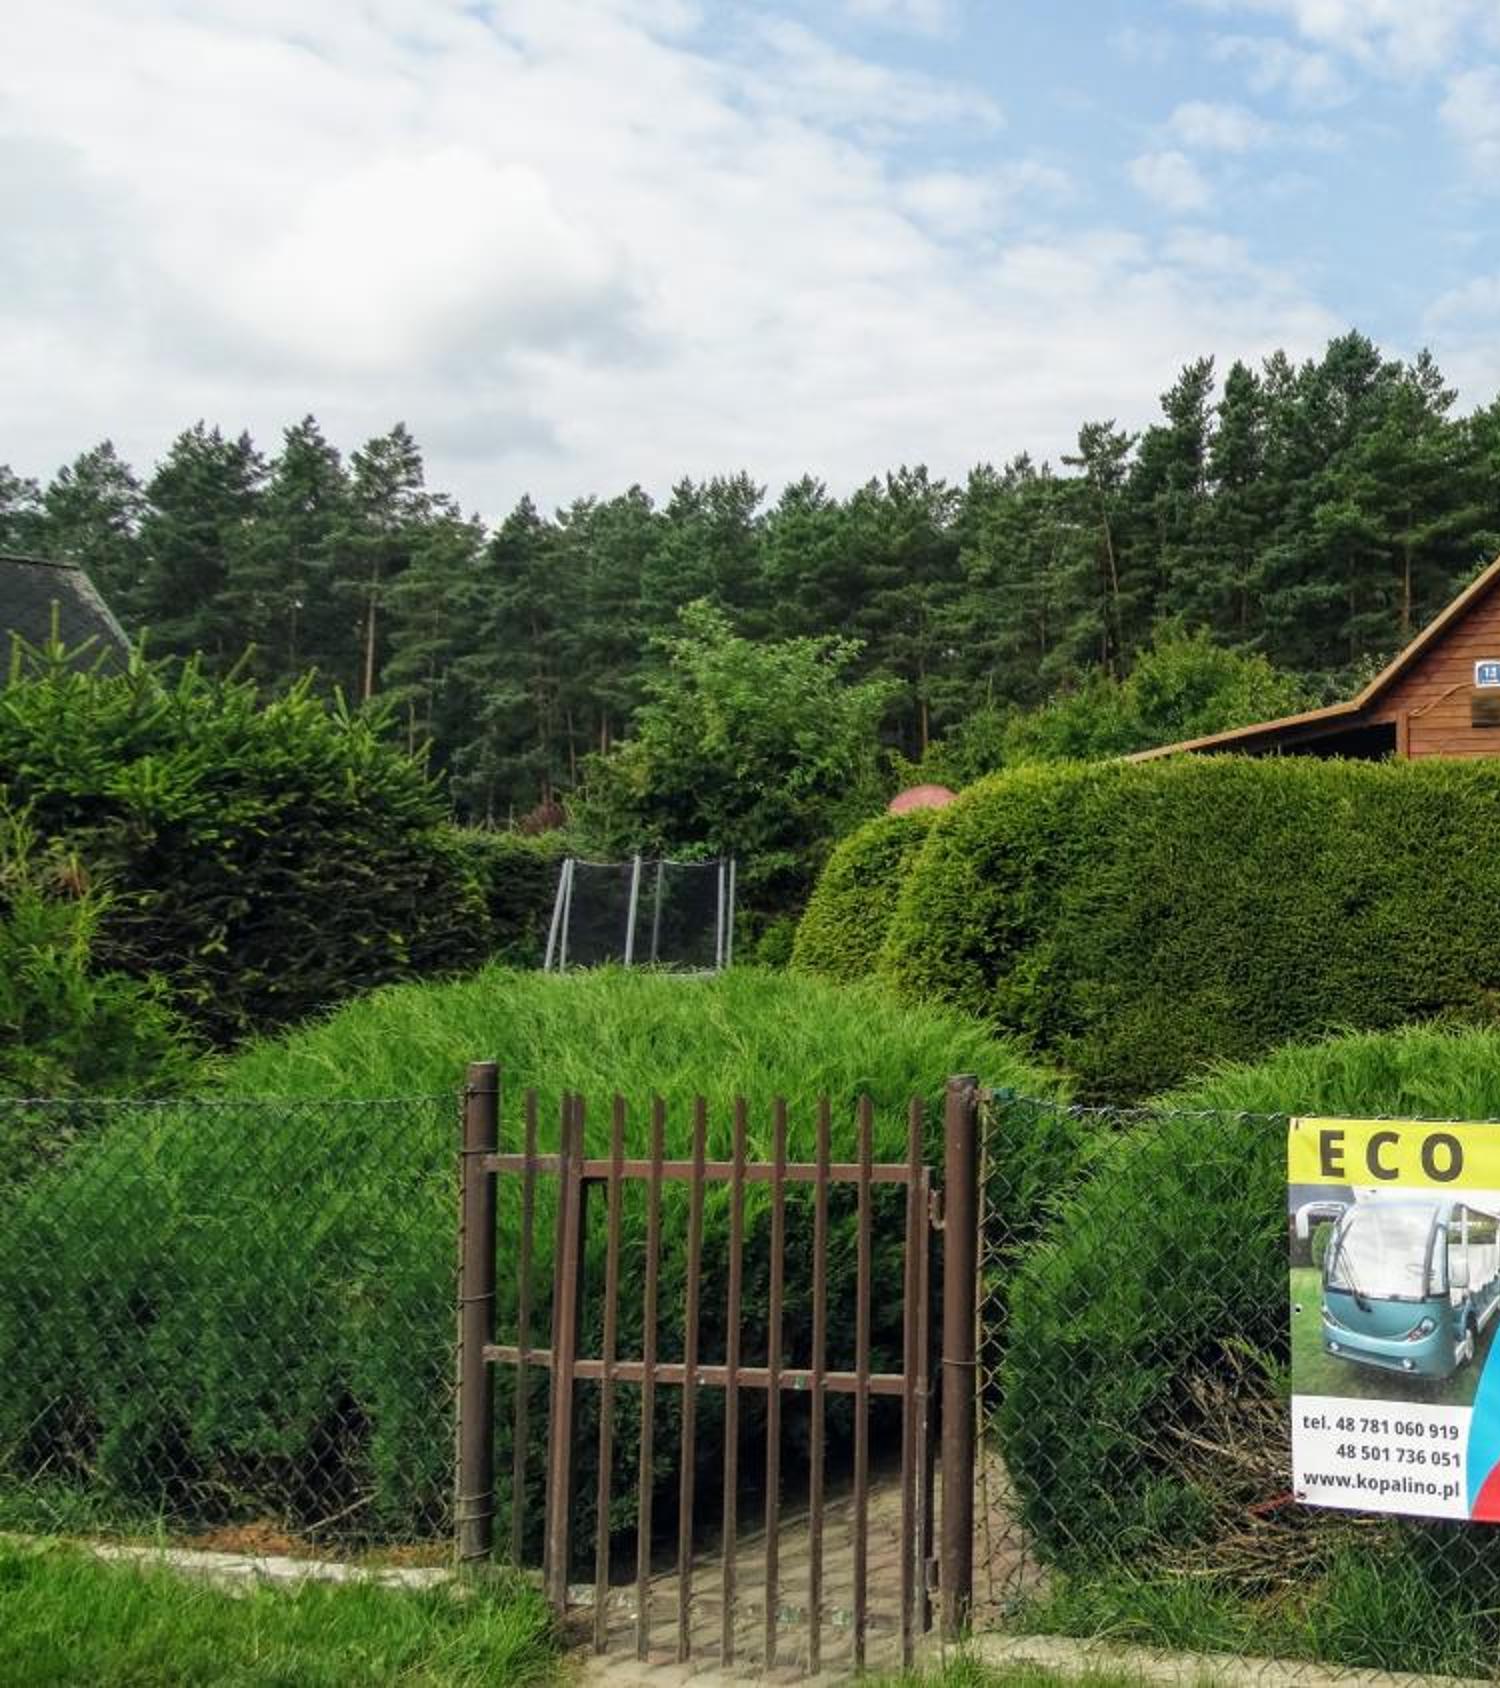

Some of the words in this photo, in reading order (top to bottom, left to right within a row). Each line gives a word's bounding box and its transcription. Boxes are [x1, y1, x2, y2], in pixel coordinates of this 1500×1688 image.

[1320, 1130, 1463, 1182] ECO
[1303, 1416, 1331, 1430] tel.
[1336, 1416, 1355, 1432] 48
[1360, 1418, 1389, 1434] 781
[1395, 1421, 1424, 1437] 060
[1429, 1424, 1459, 1440] 919
[1336, 1444, 1356, 1459] 48
[1361, 1446, 1390, 1461] 501
[1396, 1448, 1426, 1465] 736
[1431, 1451, 1461, 1467] 051
[1303, 1473, 1460, 1500] www.kopalino.pl
